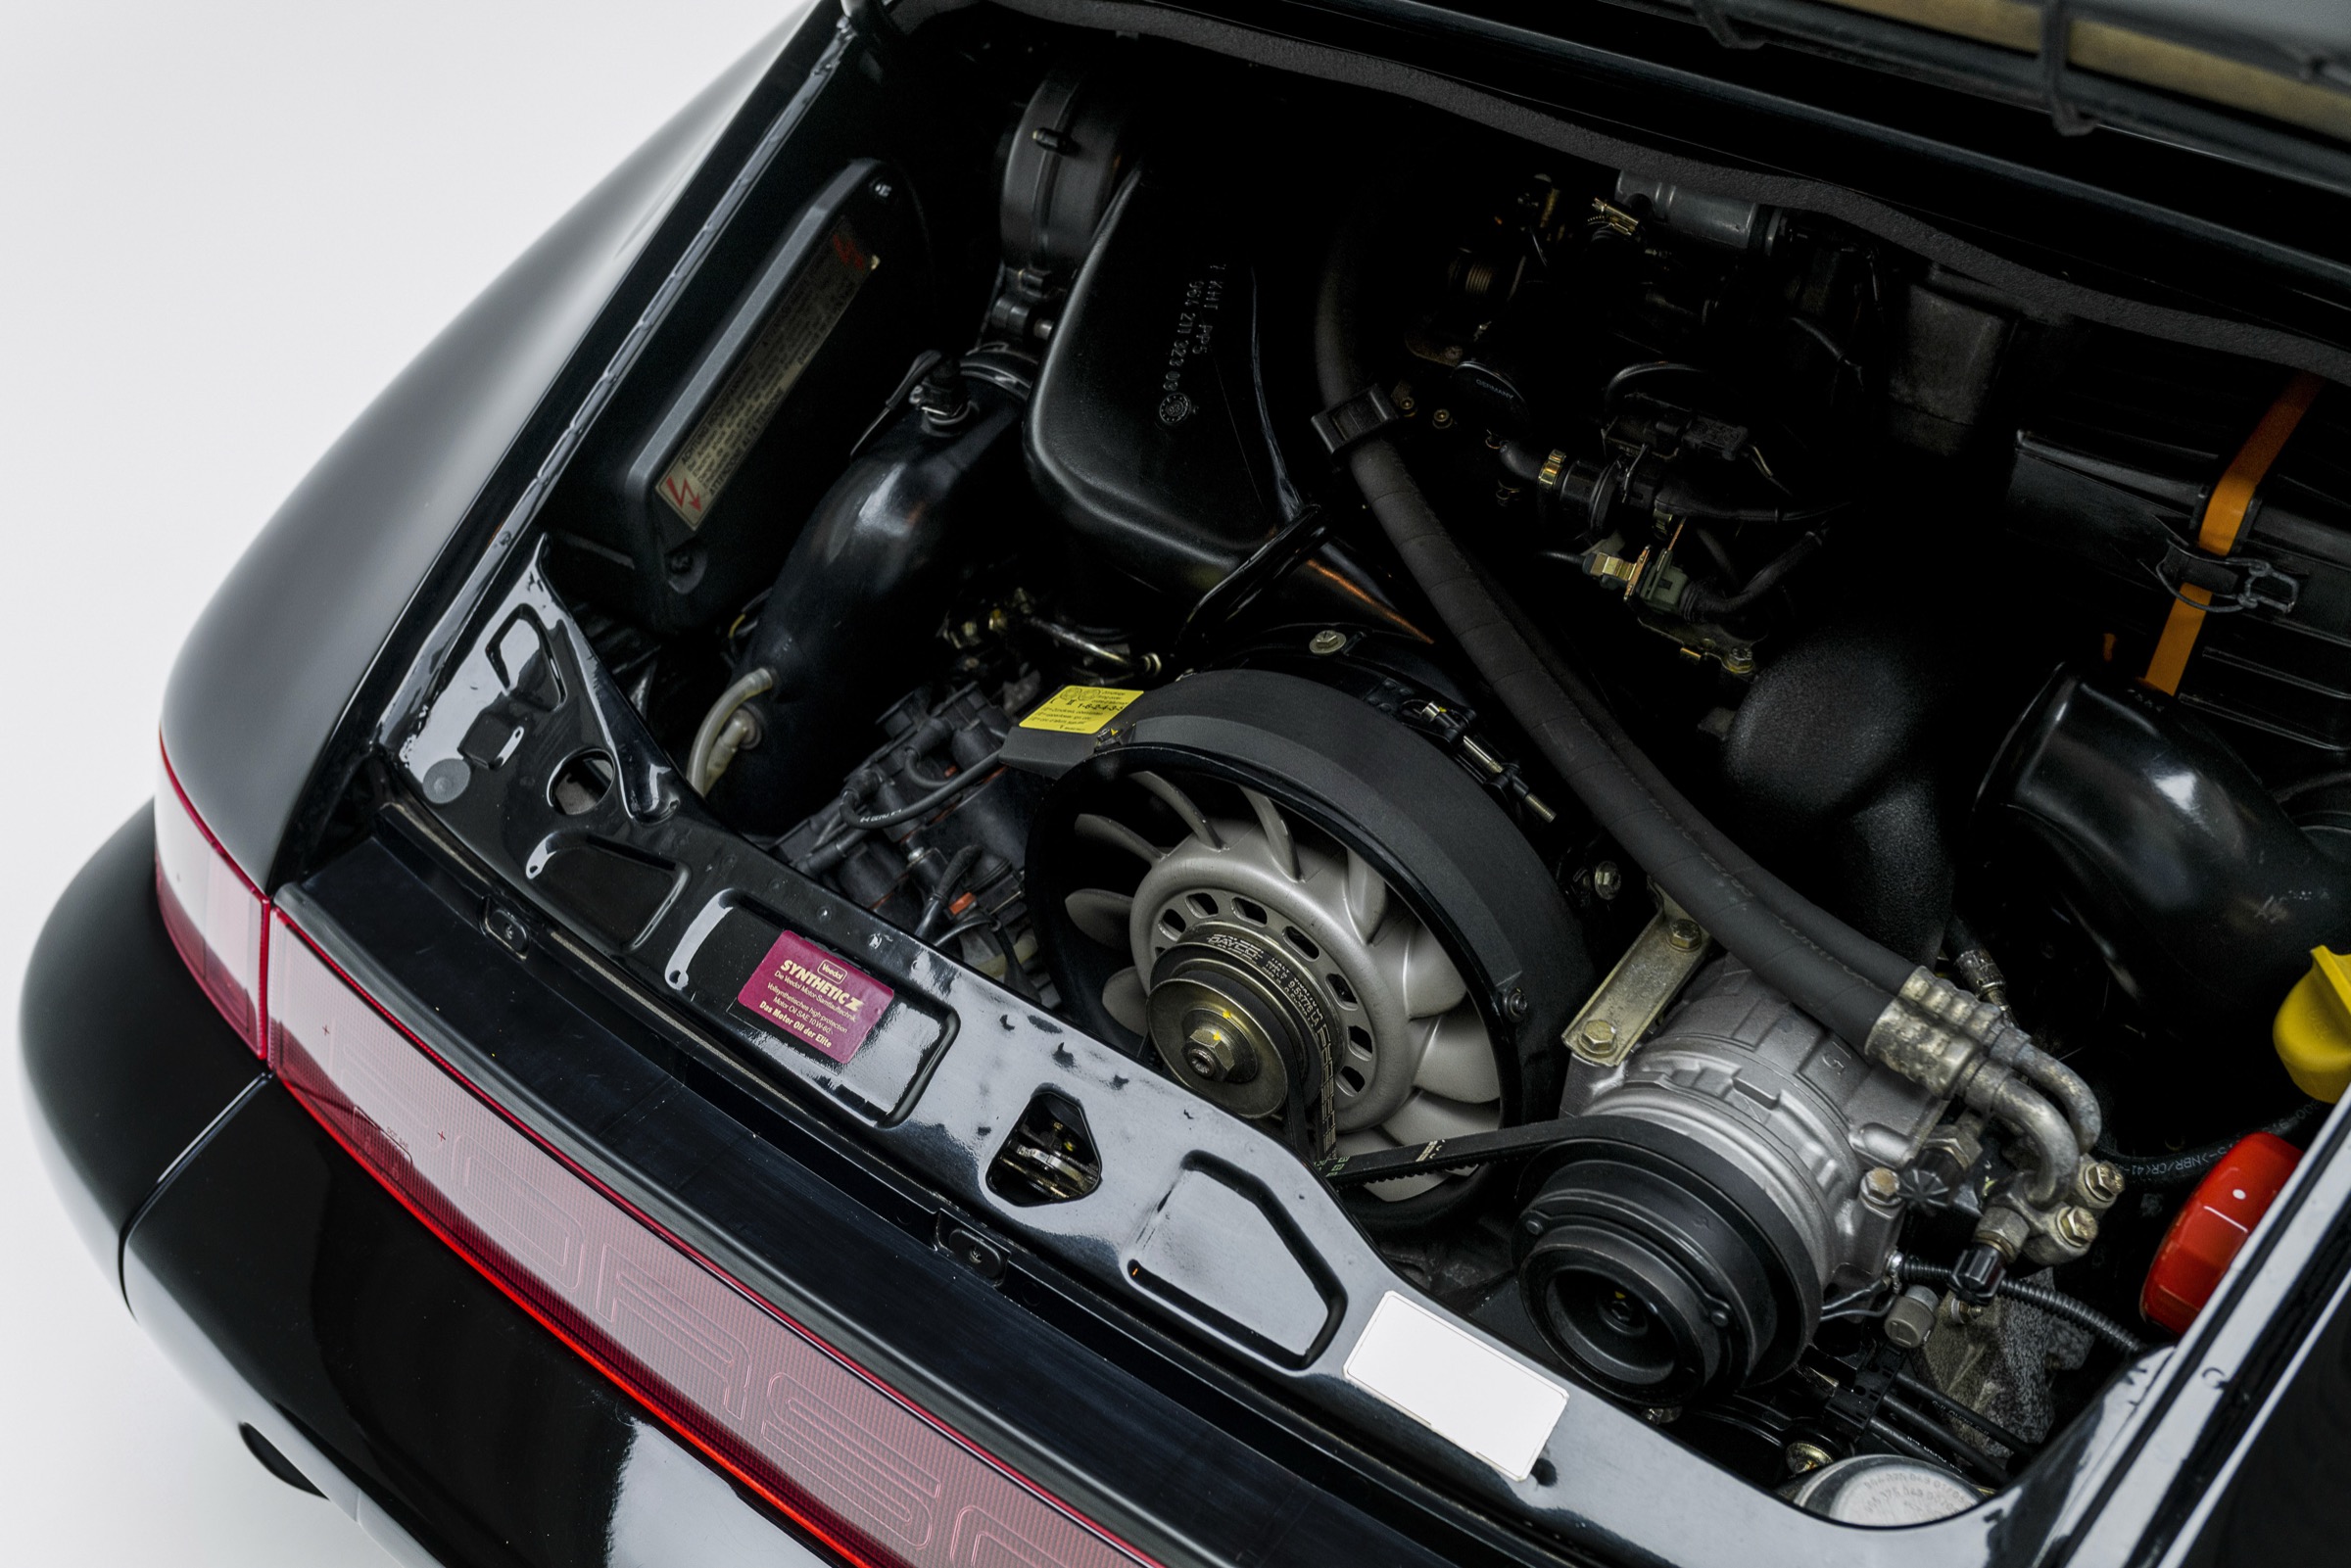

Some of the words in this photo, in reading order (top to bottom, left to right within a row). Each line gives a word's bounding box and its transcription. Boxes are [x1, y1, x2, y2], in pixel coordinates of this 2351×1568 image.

[774, 971, 785, 980] Die
[785, 974, 801, 991] Veedol
[781, 960, 850, 1004] SYNTHETIC
[822, 963, 842, 979] Veedol
[1286, 978, 1314, 1013] 9.5x776
[773, 996, 788, 1009] Motor
[789, 1006, 797, 1015] Oil
[796, 1010, 810, 1022] SAE
[809, 1007, 847, 1033] high-protection
[759, 1001, 773, 1013] Das
[772, 1008, 793, 1025] Motor
[792, 1021, 803, 1031] Oil
[802, 1027, 816, 1039] der
[815, 1033, 833, 1047] Elite
